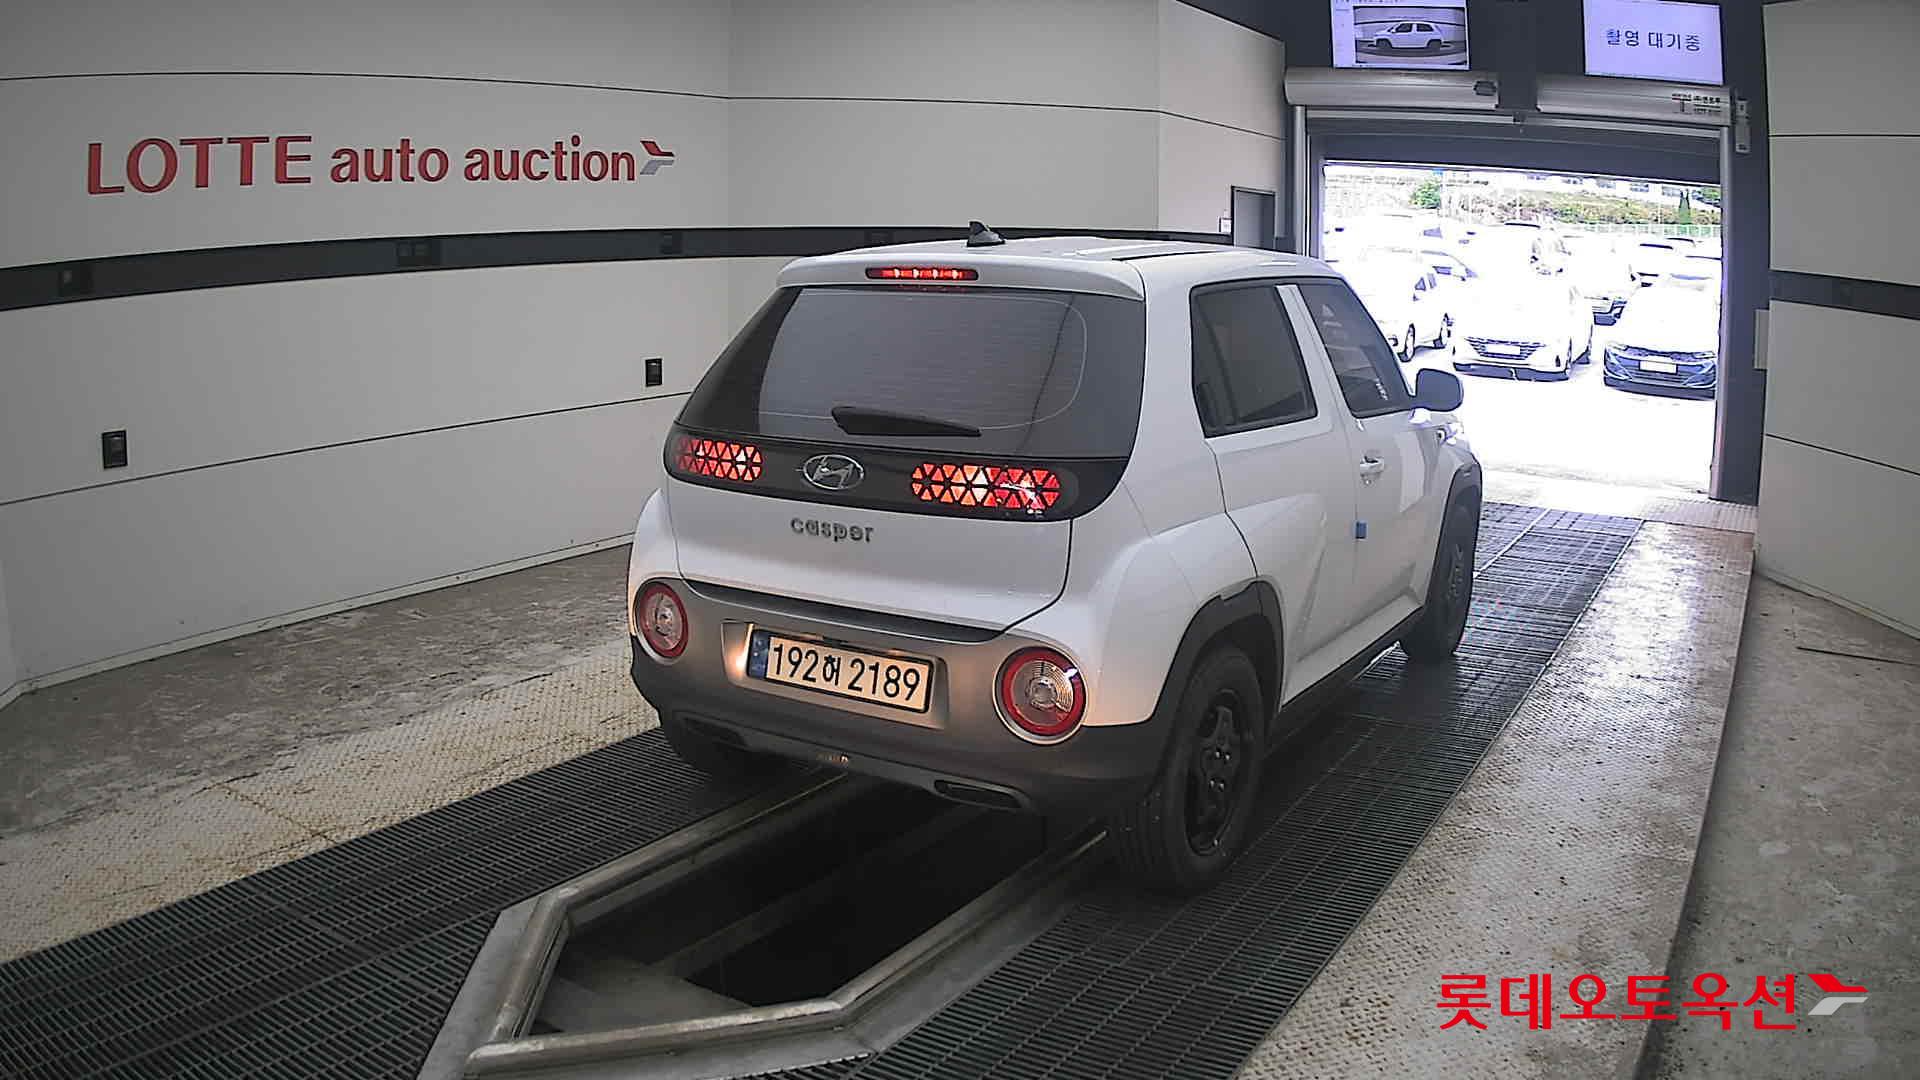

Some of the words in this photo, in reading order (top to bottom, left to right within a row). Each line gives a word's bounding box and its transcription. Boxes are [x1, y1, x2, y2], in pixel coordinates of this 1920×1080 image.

[1648, 31, 1700, 52] 대기중
[87, 135, 312, 195] LOTTE
[329, 137, 449, 183] auto
[463, 134, 636, 182] auction
[790, 517, 875, 543] casper
[773, 643, 842, 687] 192허
[847, 657, 921, 702] 2189
